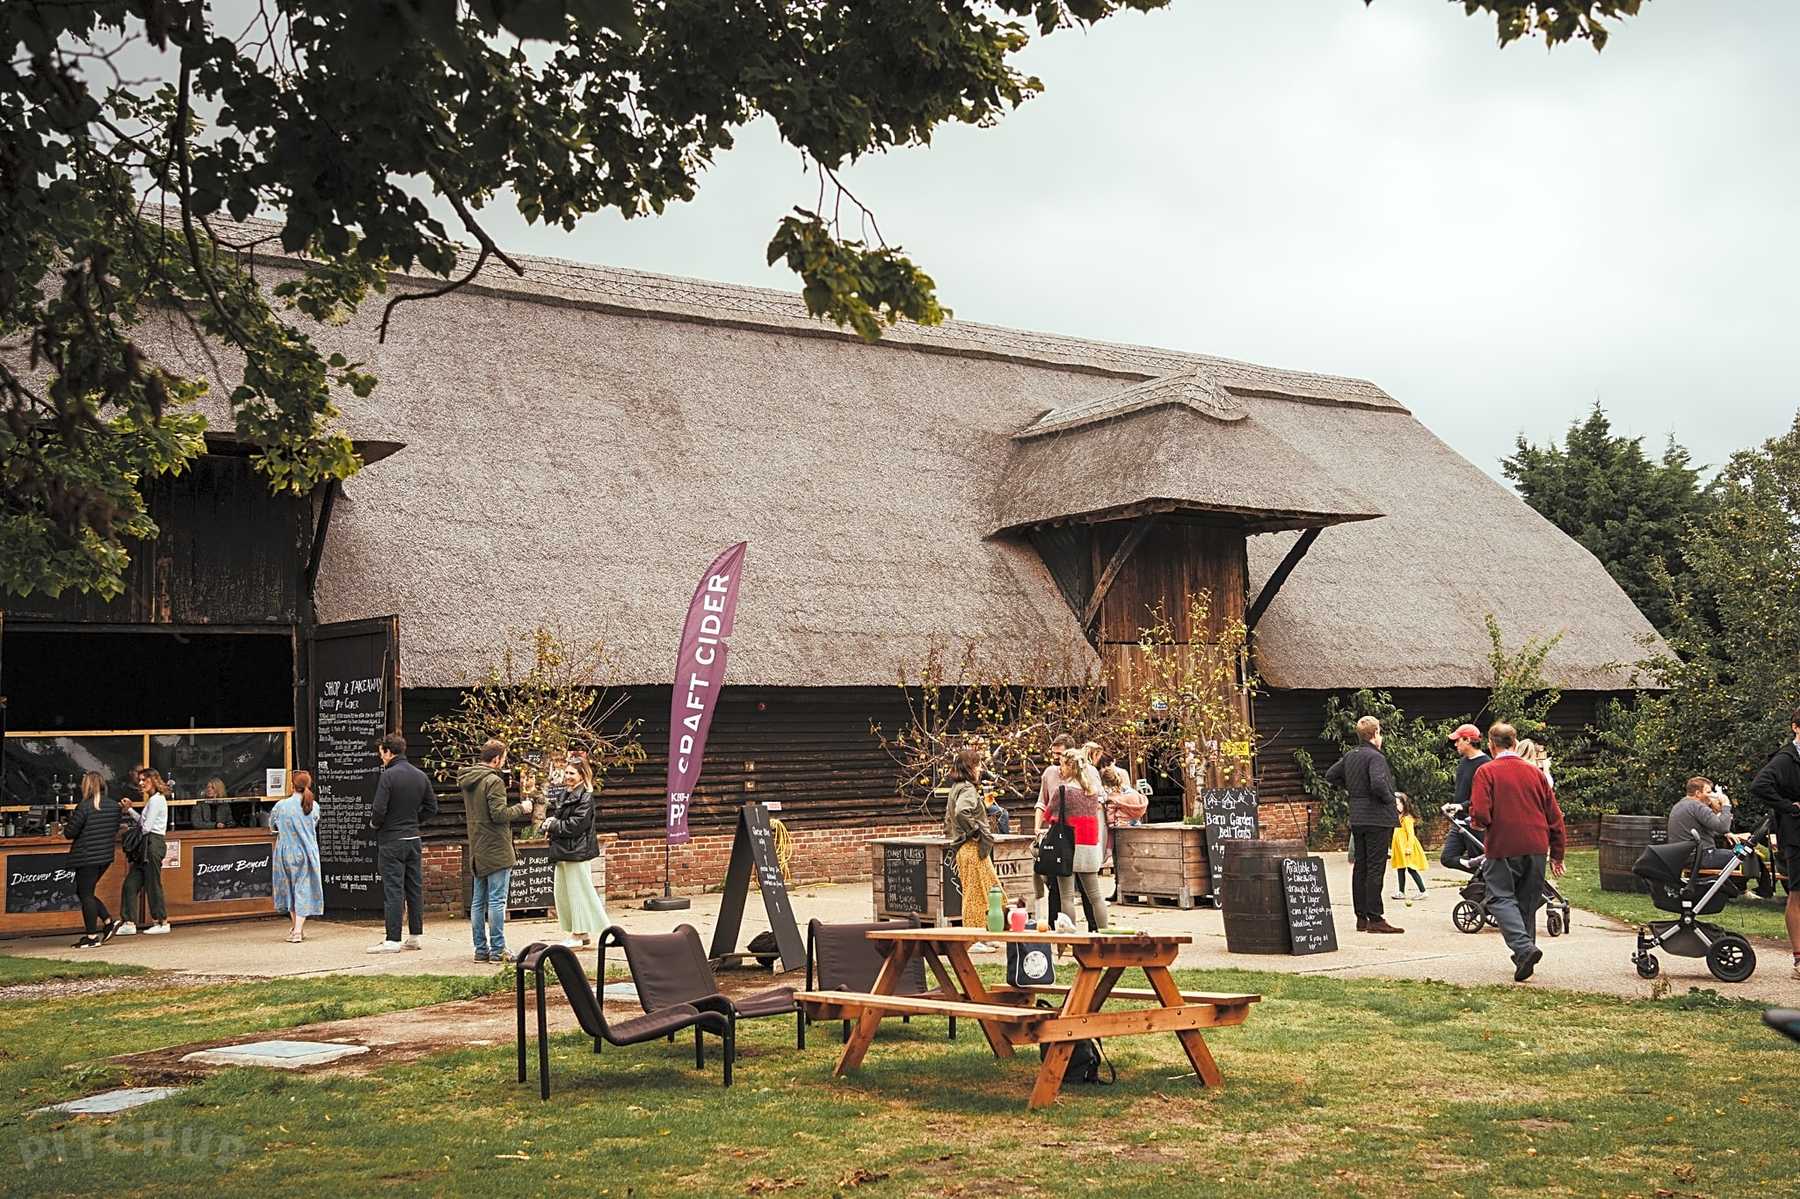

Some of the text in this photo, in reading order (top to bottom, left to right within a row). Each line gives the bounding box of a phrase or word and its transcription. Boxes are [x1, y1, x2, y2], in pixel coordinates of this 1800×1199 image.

[695, 574, 730, 665] CIDER
[324, 678, 382, 696] SHOP & TAKEAWAY
[1206, 812, 1254, 827] Barn Garden
[1218, 826, 1252, 839] Bell Tents
[197, 856, 269, 875] Discover Beyond
[10, 870, 76, 886] Discover Bey
[529, 876, 554, 885] BURGER
[529, 886, 552, 894] BURGER
